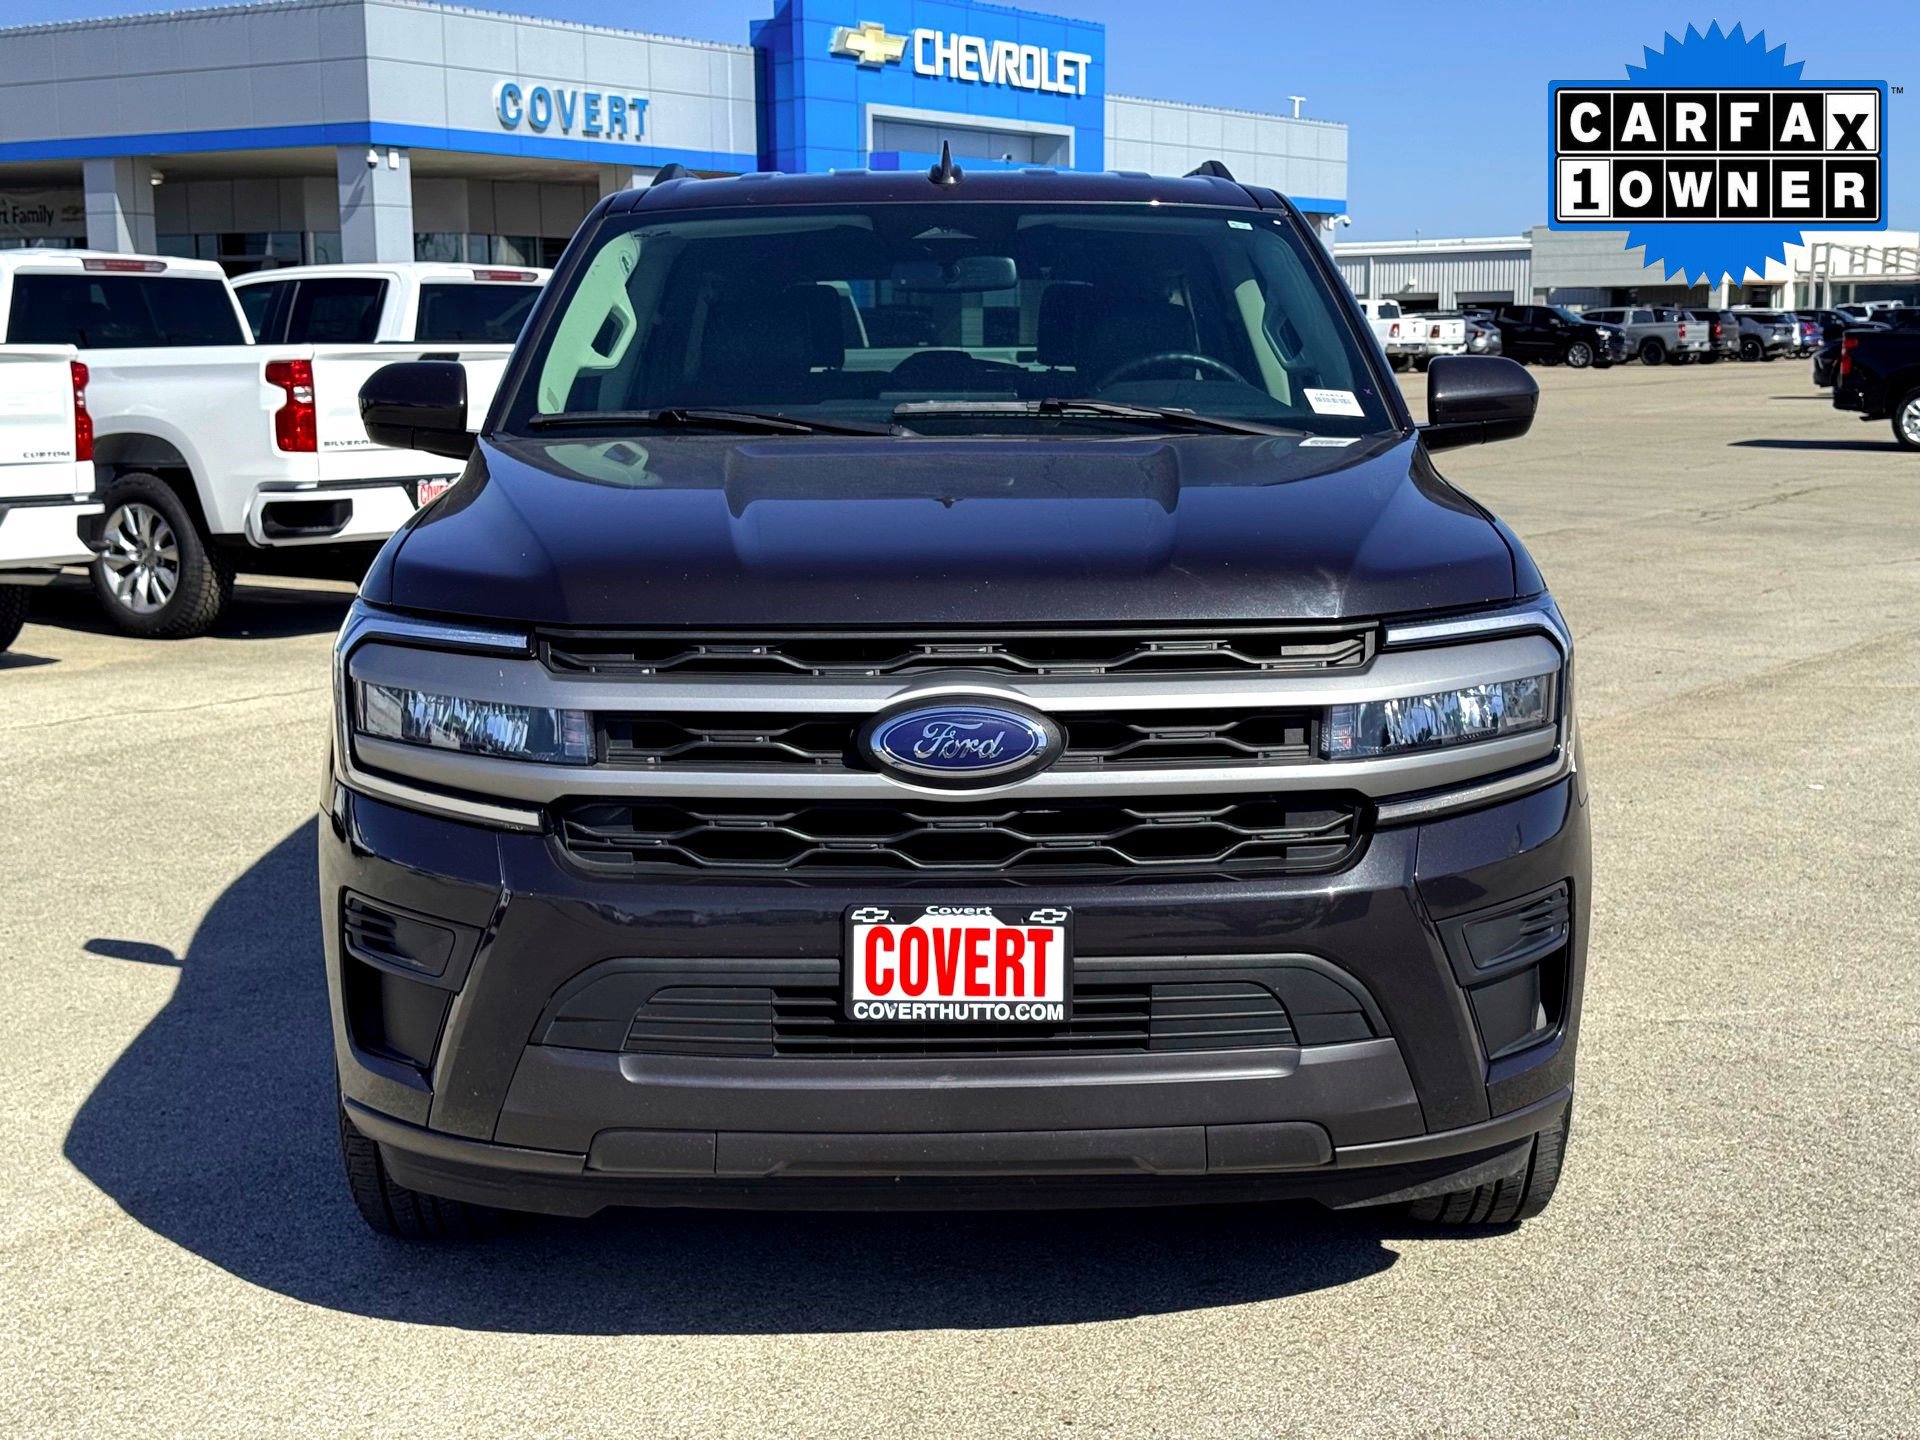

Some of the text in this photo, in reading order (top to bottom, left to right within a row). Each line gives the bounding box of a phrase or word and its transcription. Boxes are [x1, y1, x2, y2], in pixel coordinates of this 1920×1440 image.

[913, 27, 1092, 96] CHEVROLET
[494, 80, 650, 141] COVERT
[12, 204, 54, 227] Family
[323, 439, 369, 447] SILVERA
[913, 721, 1005, 759] Ford
[925, 906, 992, 916] Covert
[865, 926, 1054, 997] COVERT
[853, 1003, 1063, 1020] COVERTHUTTO.COM
